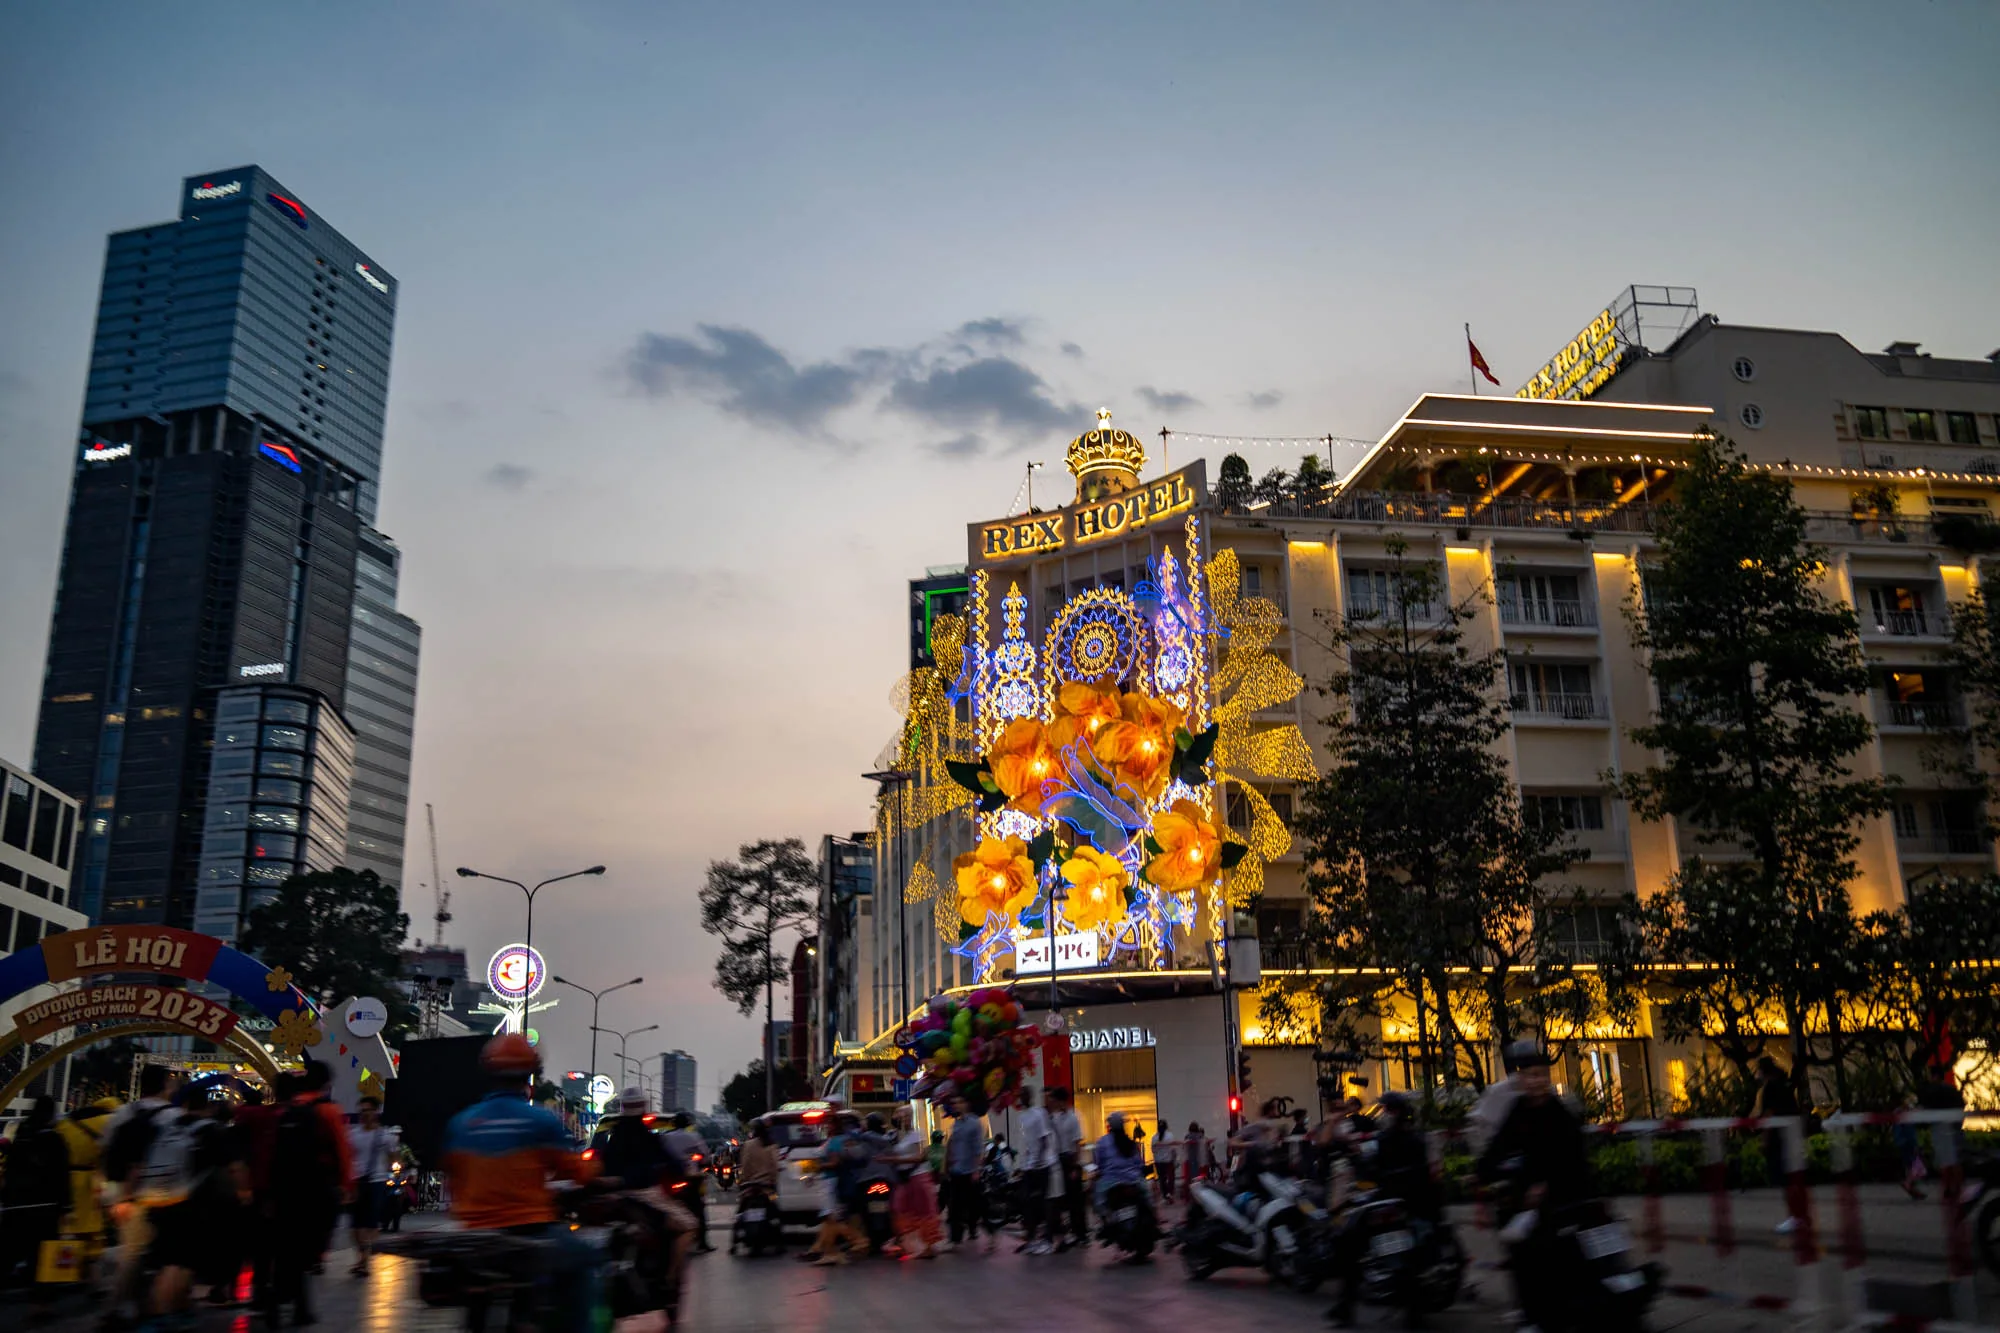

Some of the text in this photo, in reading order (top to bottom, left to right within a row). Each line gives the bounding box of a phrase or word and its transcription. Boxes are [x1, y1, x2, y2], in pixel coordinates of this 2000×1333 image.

[1554, 309, 1616, 377] HOTEL
[984, 476, 1193, 557] REX HOTEL
[240, 663, 285, 677] FUSION
[125, 935, 188, 970] HỘI
[140, 988, 228, 1035] 2023
[1070, 1027, 1156, 1052] CHANEL
